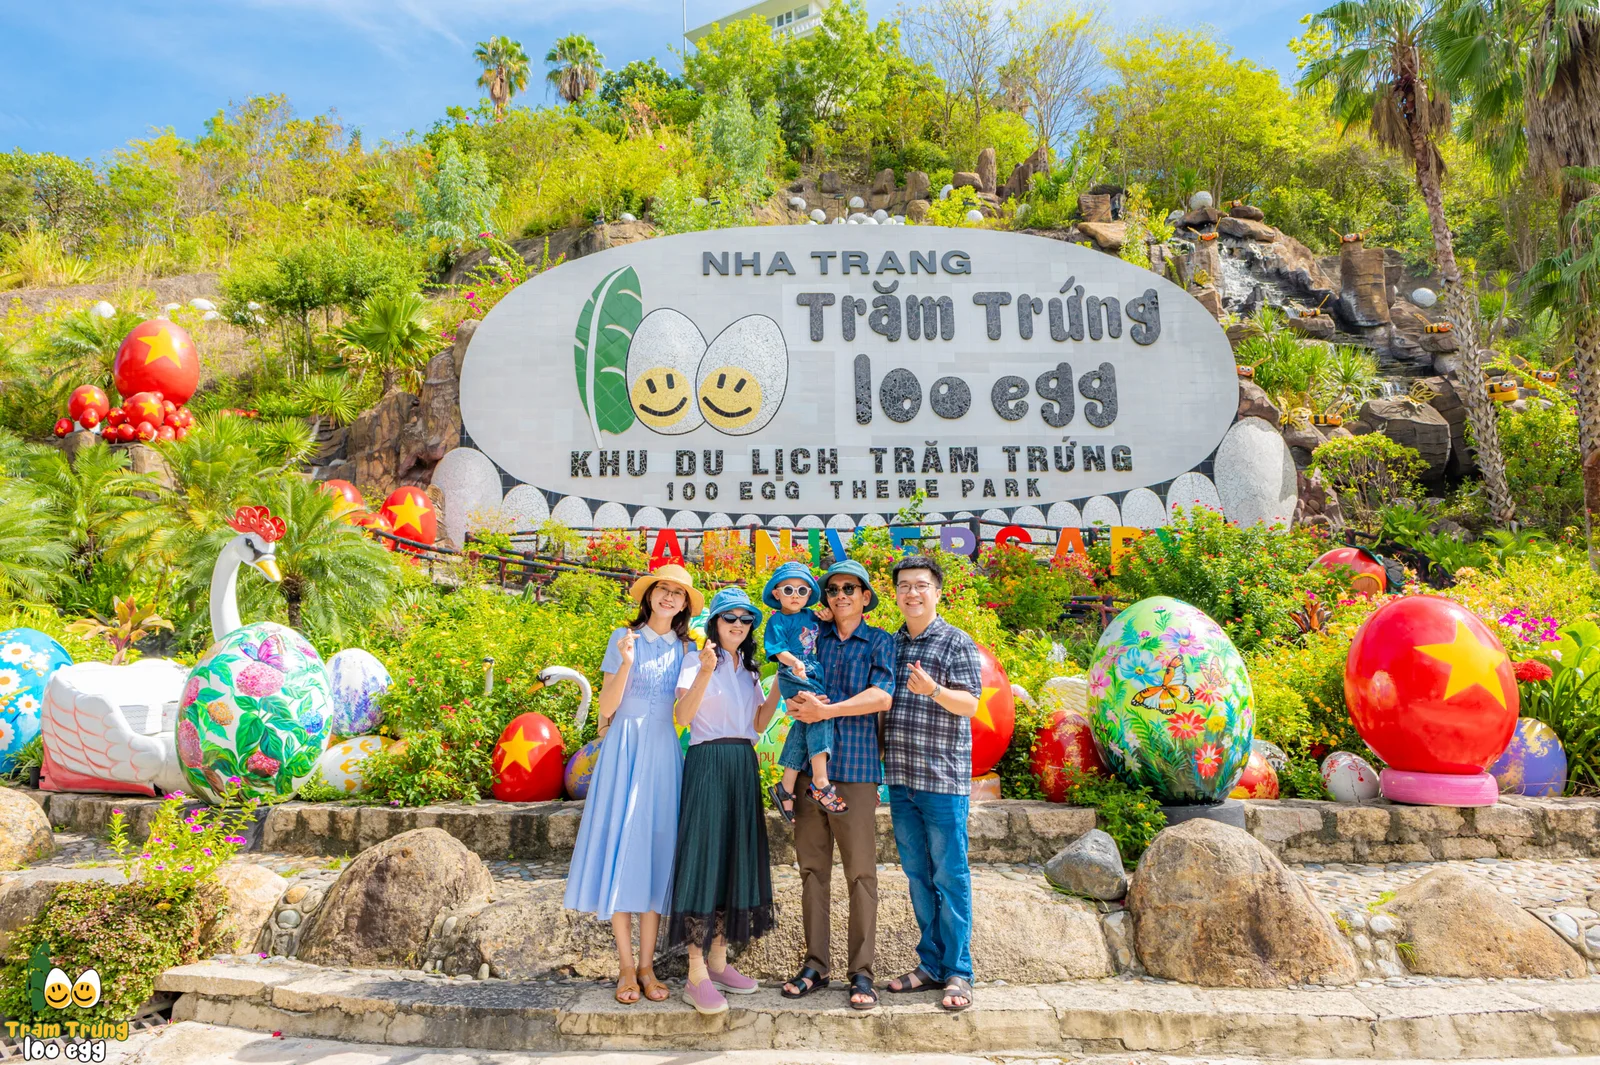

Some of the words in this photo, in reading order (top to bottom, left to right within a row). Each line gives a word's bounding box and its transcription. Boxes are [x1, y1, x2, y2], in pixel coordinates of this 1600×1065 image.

[702, 251, 796, 275] NHA
[810, 250, 972, 275] TRANG
[796, 279, 955, 342] Trăm
[972, 275, 1162, 346] Trứng
[990, 361, 1119, 428] egg
[570, 449, 648, 478] KHU
[675, 449, 724, 477] DU
[751, 447, 839, 481] LỊCH
[869, 440, 980, 474] TRĂM
[1002, 436, 1133, 473] TRỨNG
[666, 481, 719, 501] 100
[739, 480, 800, 500] EGG
[829, 479, 940, 499] THEME
[961, 477, 1042, 498] PARK
